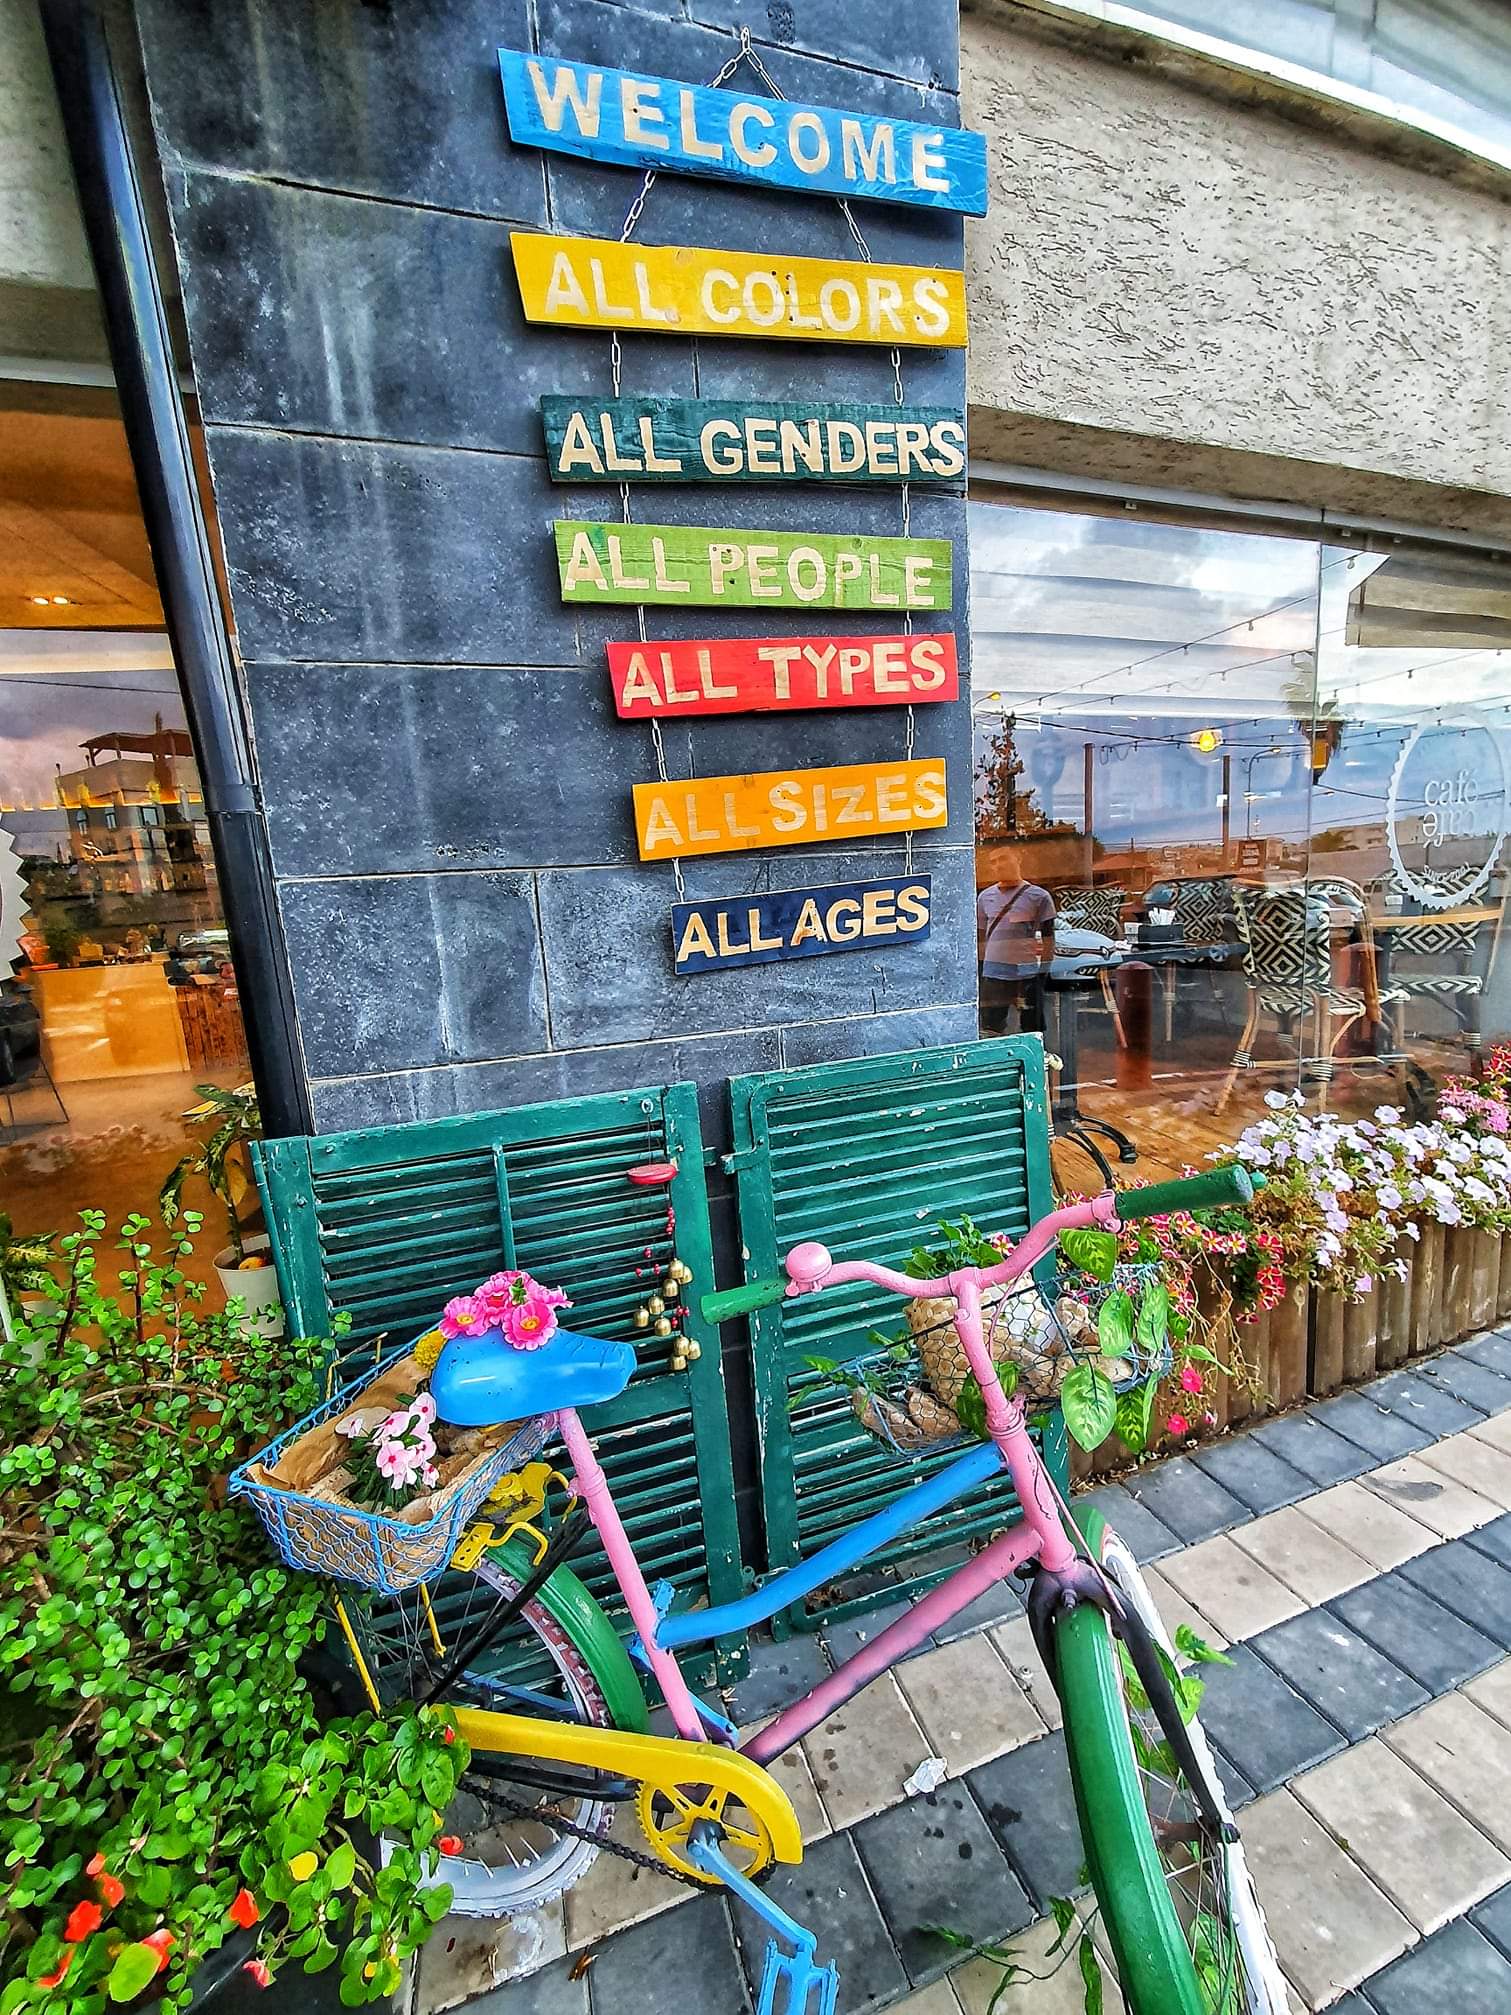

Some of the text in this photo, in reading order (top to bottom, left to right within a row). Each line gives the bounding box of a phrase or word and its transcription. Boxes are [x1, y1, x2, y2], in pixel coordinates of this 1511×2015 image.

[527, 60, 951, 193] WELCOME
[545, 251, 951, 338] ALL COLORS
[558, 411, 965, 477] ALL GENDERS
[564, 531, 936, 607] ALL PEOPLE
[621, 640, 946, 708] ALL TYPES
[644, 772, 946, 850] ALL SIZES
[1424, 768, 1480, 807] café
[676, 885, 931, 963] ALL AGES
